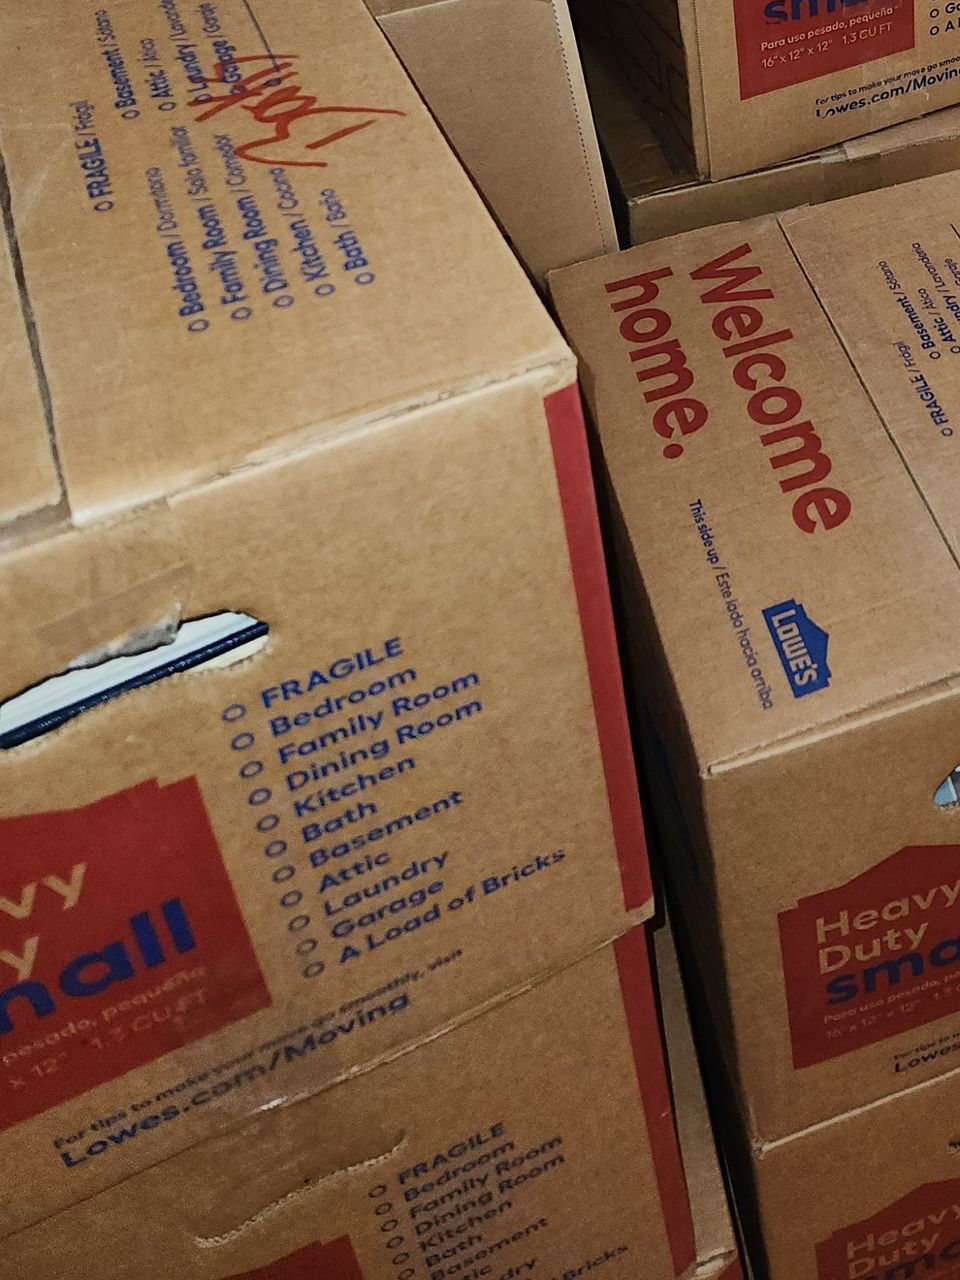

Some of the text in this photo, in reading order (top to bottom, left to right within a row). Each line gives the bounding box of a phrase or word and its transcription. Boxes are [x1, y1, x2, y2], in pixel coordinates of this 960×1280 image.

[761, 7, 893, 51] Para uso pesado, pequeña
[842, 33, 857, 45] 1.3
[859, 26, 877, 40] CU
[879, 22, 893, 34] FT
[945, 21, 955, 32] A
[102, 48, 136, 110] Basement
[145, 70, 173, 98] Attic
[175, 44, 208, 93] Laundry
[212, 39, 242, 84] Garage
[831, 92, 847, 103] tips
[848, 86, 857, 95] to
[858, 80, 882, 92] make
[883, 74, 901, 86] your
[903, 67, 926, 78] move
[927, 63, 938, 73] go
[75, 138, 113, 199] FRAGILE
[237, 195, 267, 240] Room
[270, 168, 330, 283] Kitchen Cocina
[167, 241, 204, 317] Bedroom
[198, 204, 248, 305] Family Room
[254, 239, 289, 293] Dining
[334, 231, 368, 271] Bath
[897, 296, 936, 350] Basement
[934, 317, 956, 343] Attic
[604, 266, 709, 460] home.
[689, 242, 852, 534] Welcome
[910, 373, 948, 426] FRAGILE
[689, 499, 773, 711] This side up Este lado hacia arriba
[261, 637, 404, 709] FRAGILE
[771, 608, 818, 688] LOWE'S
[269, 668, 417, 737] Bedroom
[278, 673, 480, 764] Family Room
[286, 700, 482, 792] Dining Room
[293, 756, 416, 817] Kitchen
[301, 801, 377, 843] Bath
[309, 791, 464, 867] Basement
[319, 852, 391, 893] Attic
[323, 851, 448, 916] Laundry
[331, 881, 444, 938] Garage
[340, 849, 566, 963] A Load of Bricks
[818, 921, 929, 975] Duty
[61, 994, 408, 1167] Lowes.com/Moving
[399, 1122, 504, 1185] FRAGILE
[404, 1141, 515, 1202] Bedroom
[410, 1136, 562, 1219] Family Room
[414, 1154, 565, 1236] Dining Room
[420, 1200, 512, 1252] Kitchen
[425, 1234, 483, 1268] Bath
[849, 1232, 940, 1277] Duty
